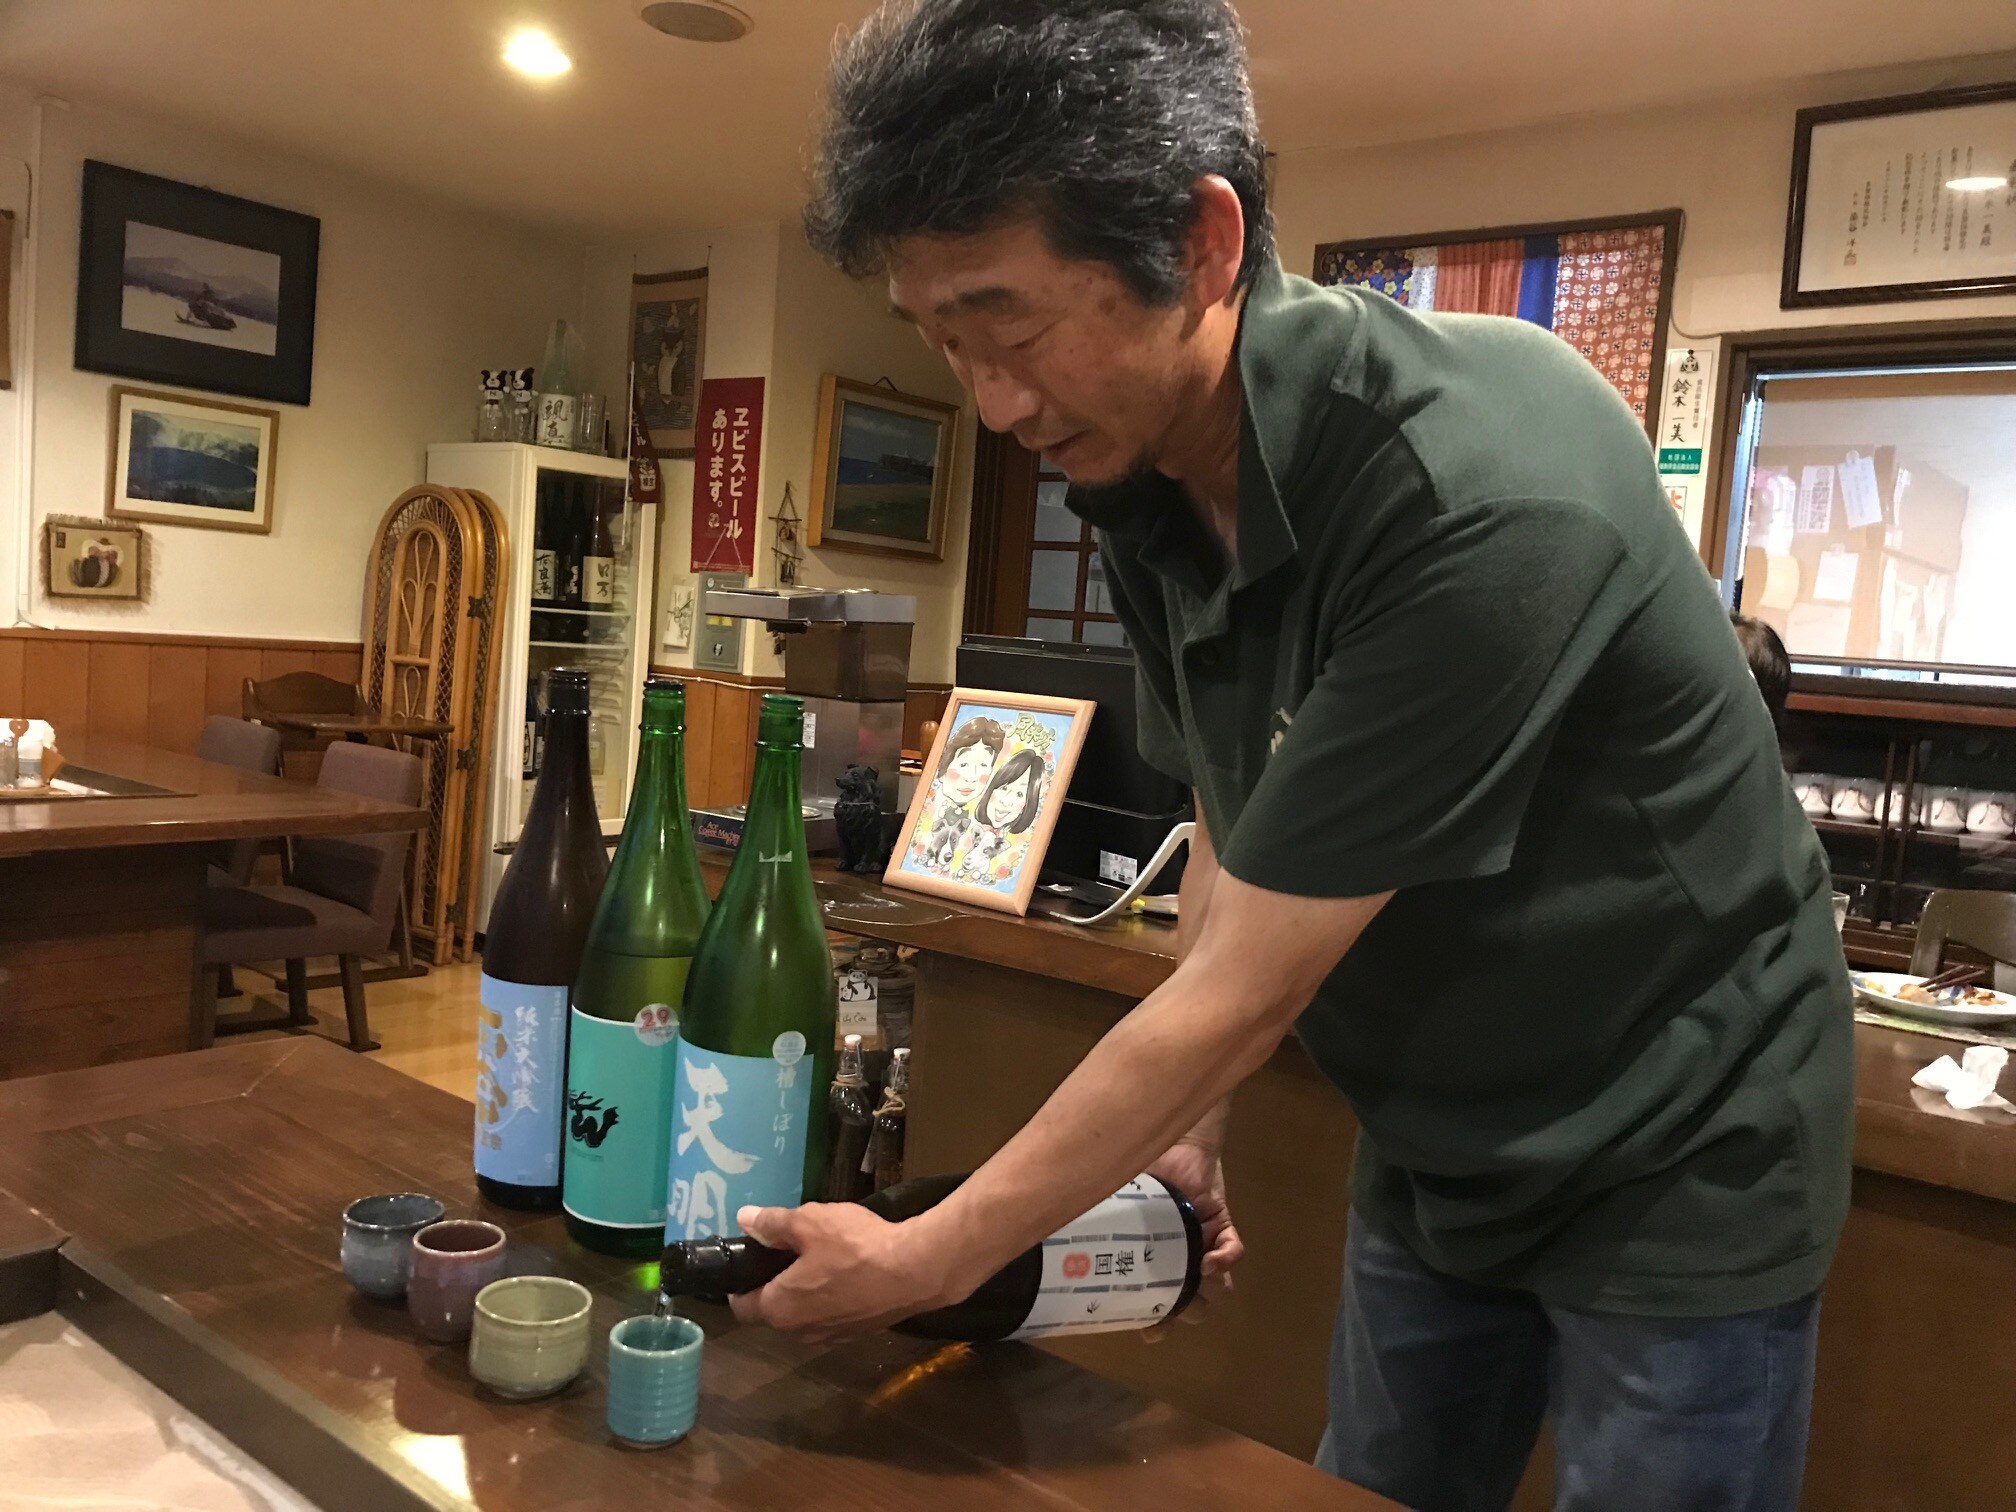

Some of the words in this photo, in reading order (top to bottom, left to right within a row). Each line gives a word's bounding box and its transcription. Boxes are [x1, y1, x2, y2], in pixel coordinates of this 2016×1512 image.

[1670, 378, 1693, 443] 鈴木一美
[708, 408, 728, 508] あります。
[725, 407, 750, 540] ヱビスビール
[641, 1007, 669, 1028] 29
[1094, 1249, 1135, 1277] 国権
